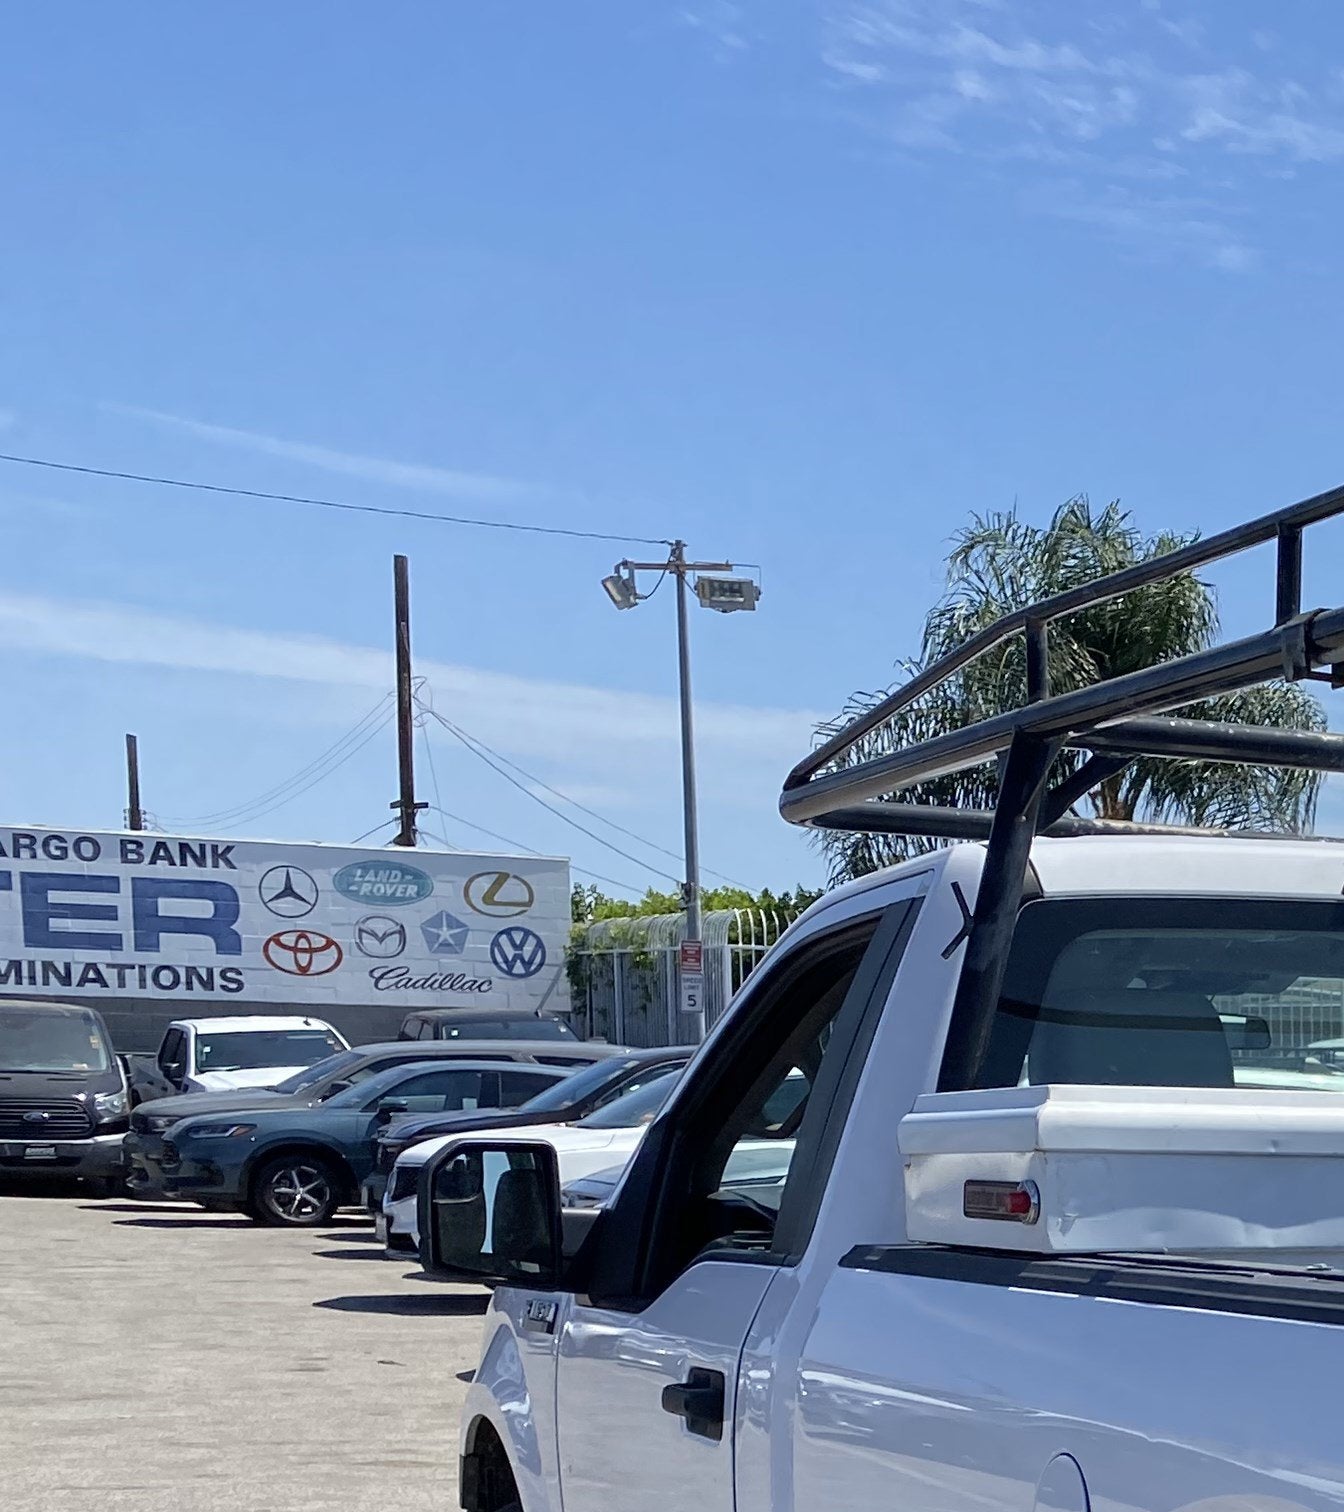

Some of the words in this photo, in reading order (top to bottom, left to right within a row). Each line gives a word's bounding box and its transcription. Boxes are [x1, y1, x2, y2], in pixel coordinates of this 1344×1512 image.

[0, 833, 101, 862] RGO
[119, 838, 238, 870] BANK
[0, 870, 242, 956] ER
[368, 965, 493, 993] Cadillac
[687, 994, 697, 1007] 5
